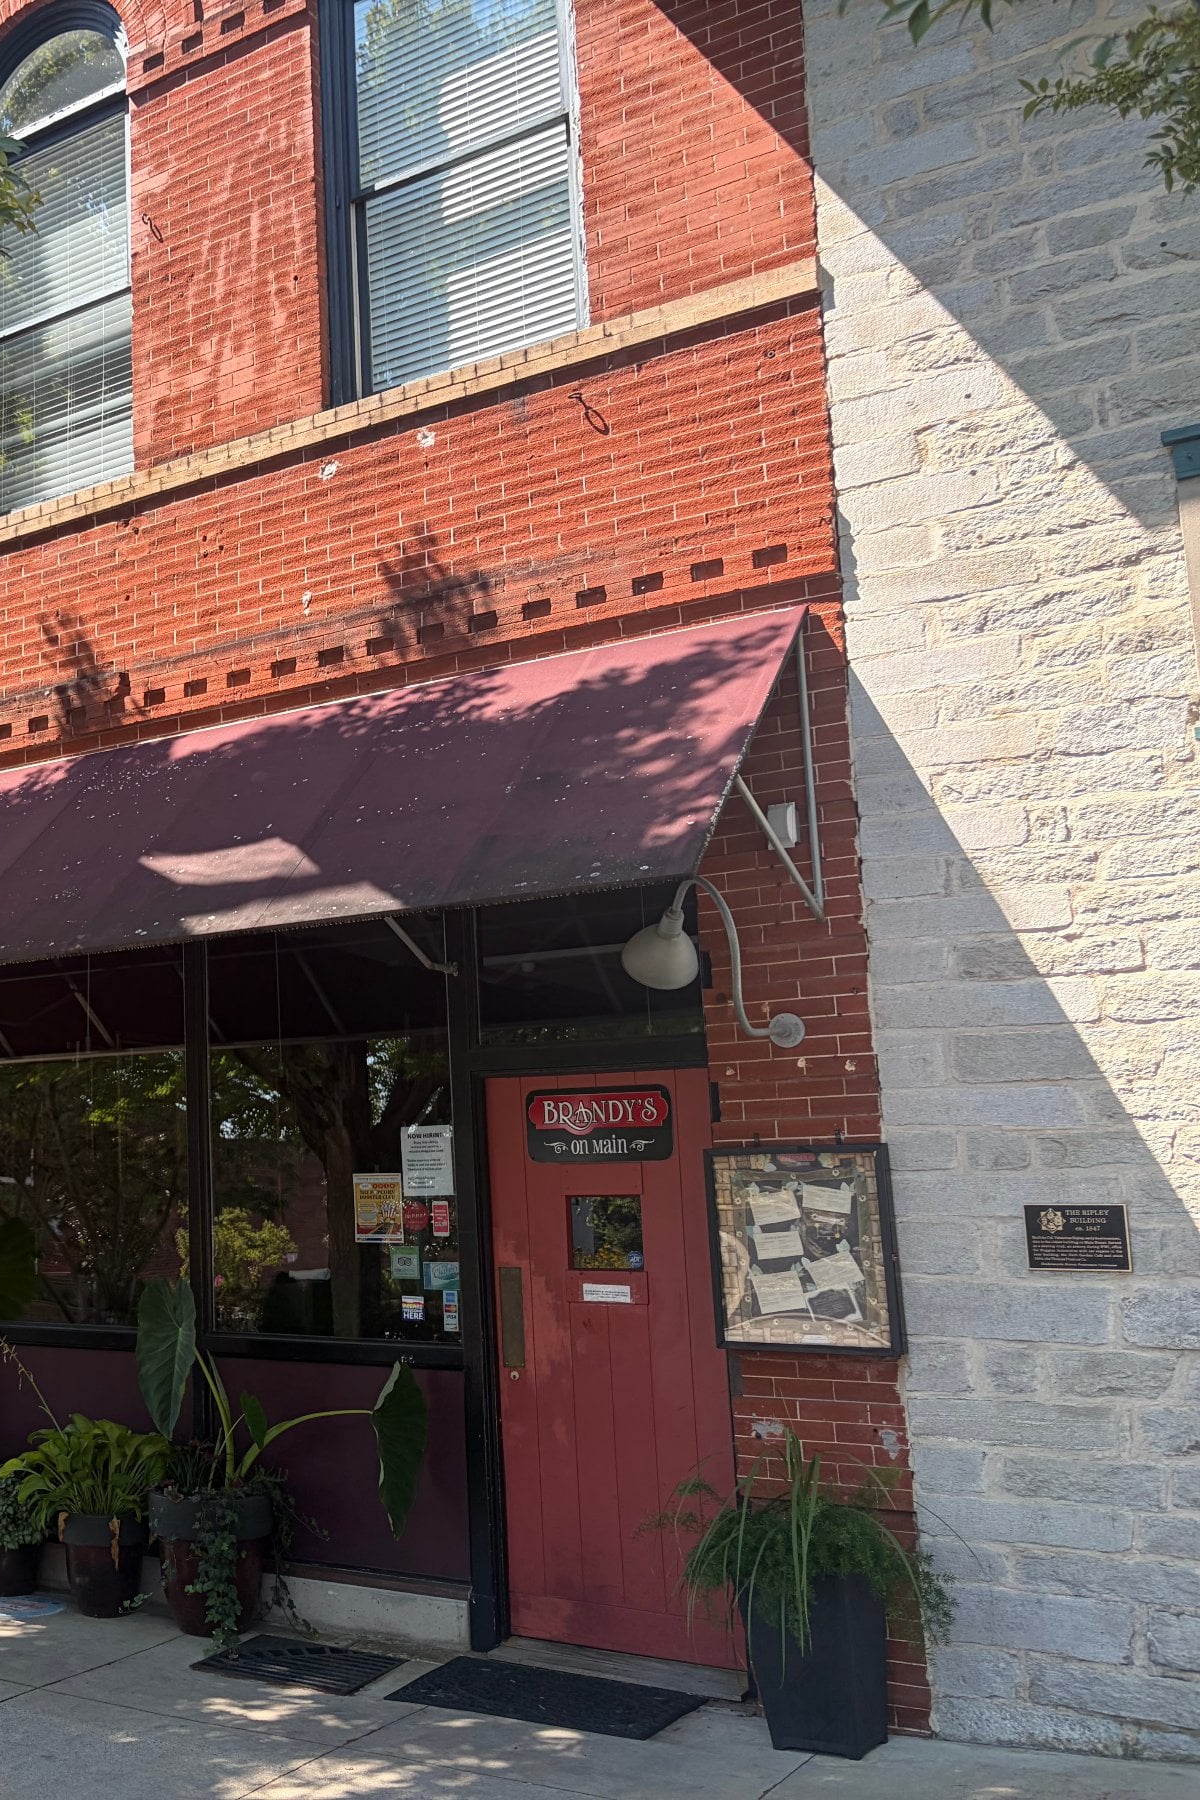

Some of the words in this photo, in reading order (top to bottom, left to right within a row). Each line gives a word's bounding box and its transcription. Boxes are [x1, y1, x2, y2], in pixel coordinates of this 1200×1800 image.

[543, 1097, 659, 1131] BRANDY'S
[571, 1139, 589, 1156] on
[593, 1134, 630, 1154] Main
[403, 1312, 424, 1320] HERE
